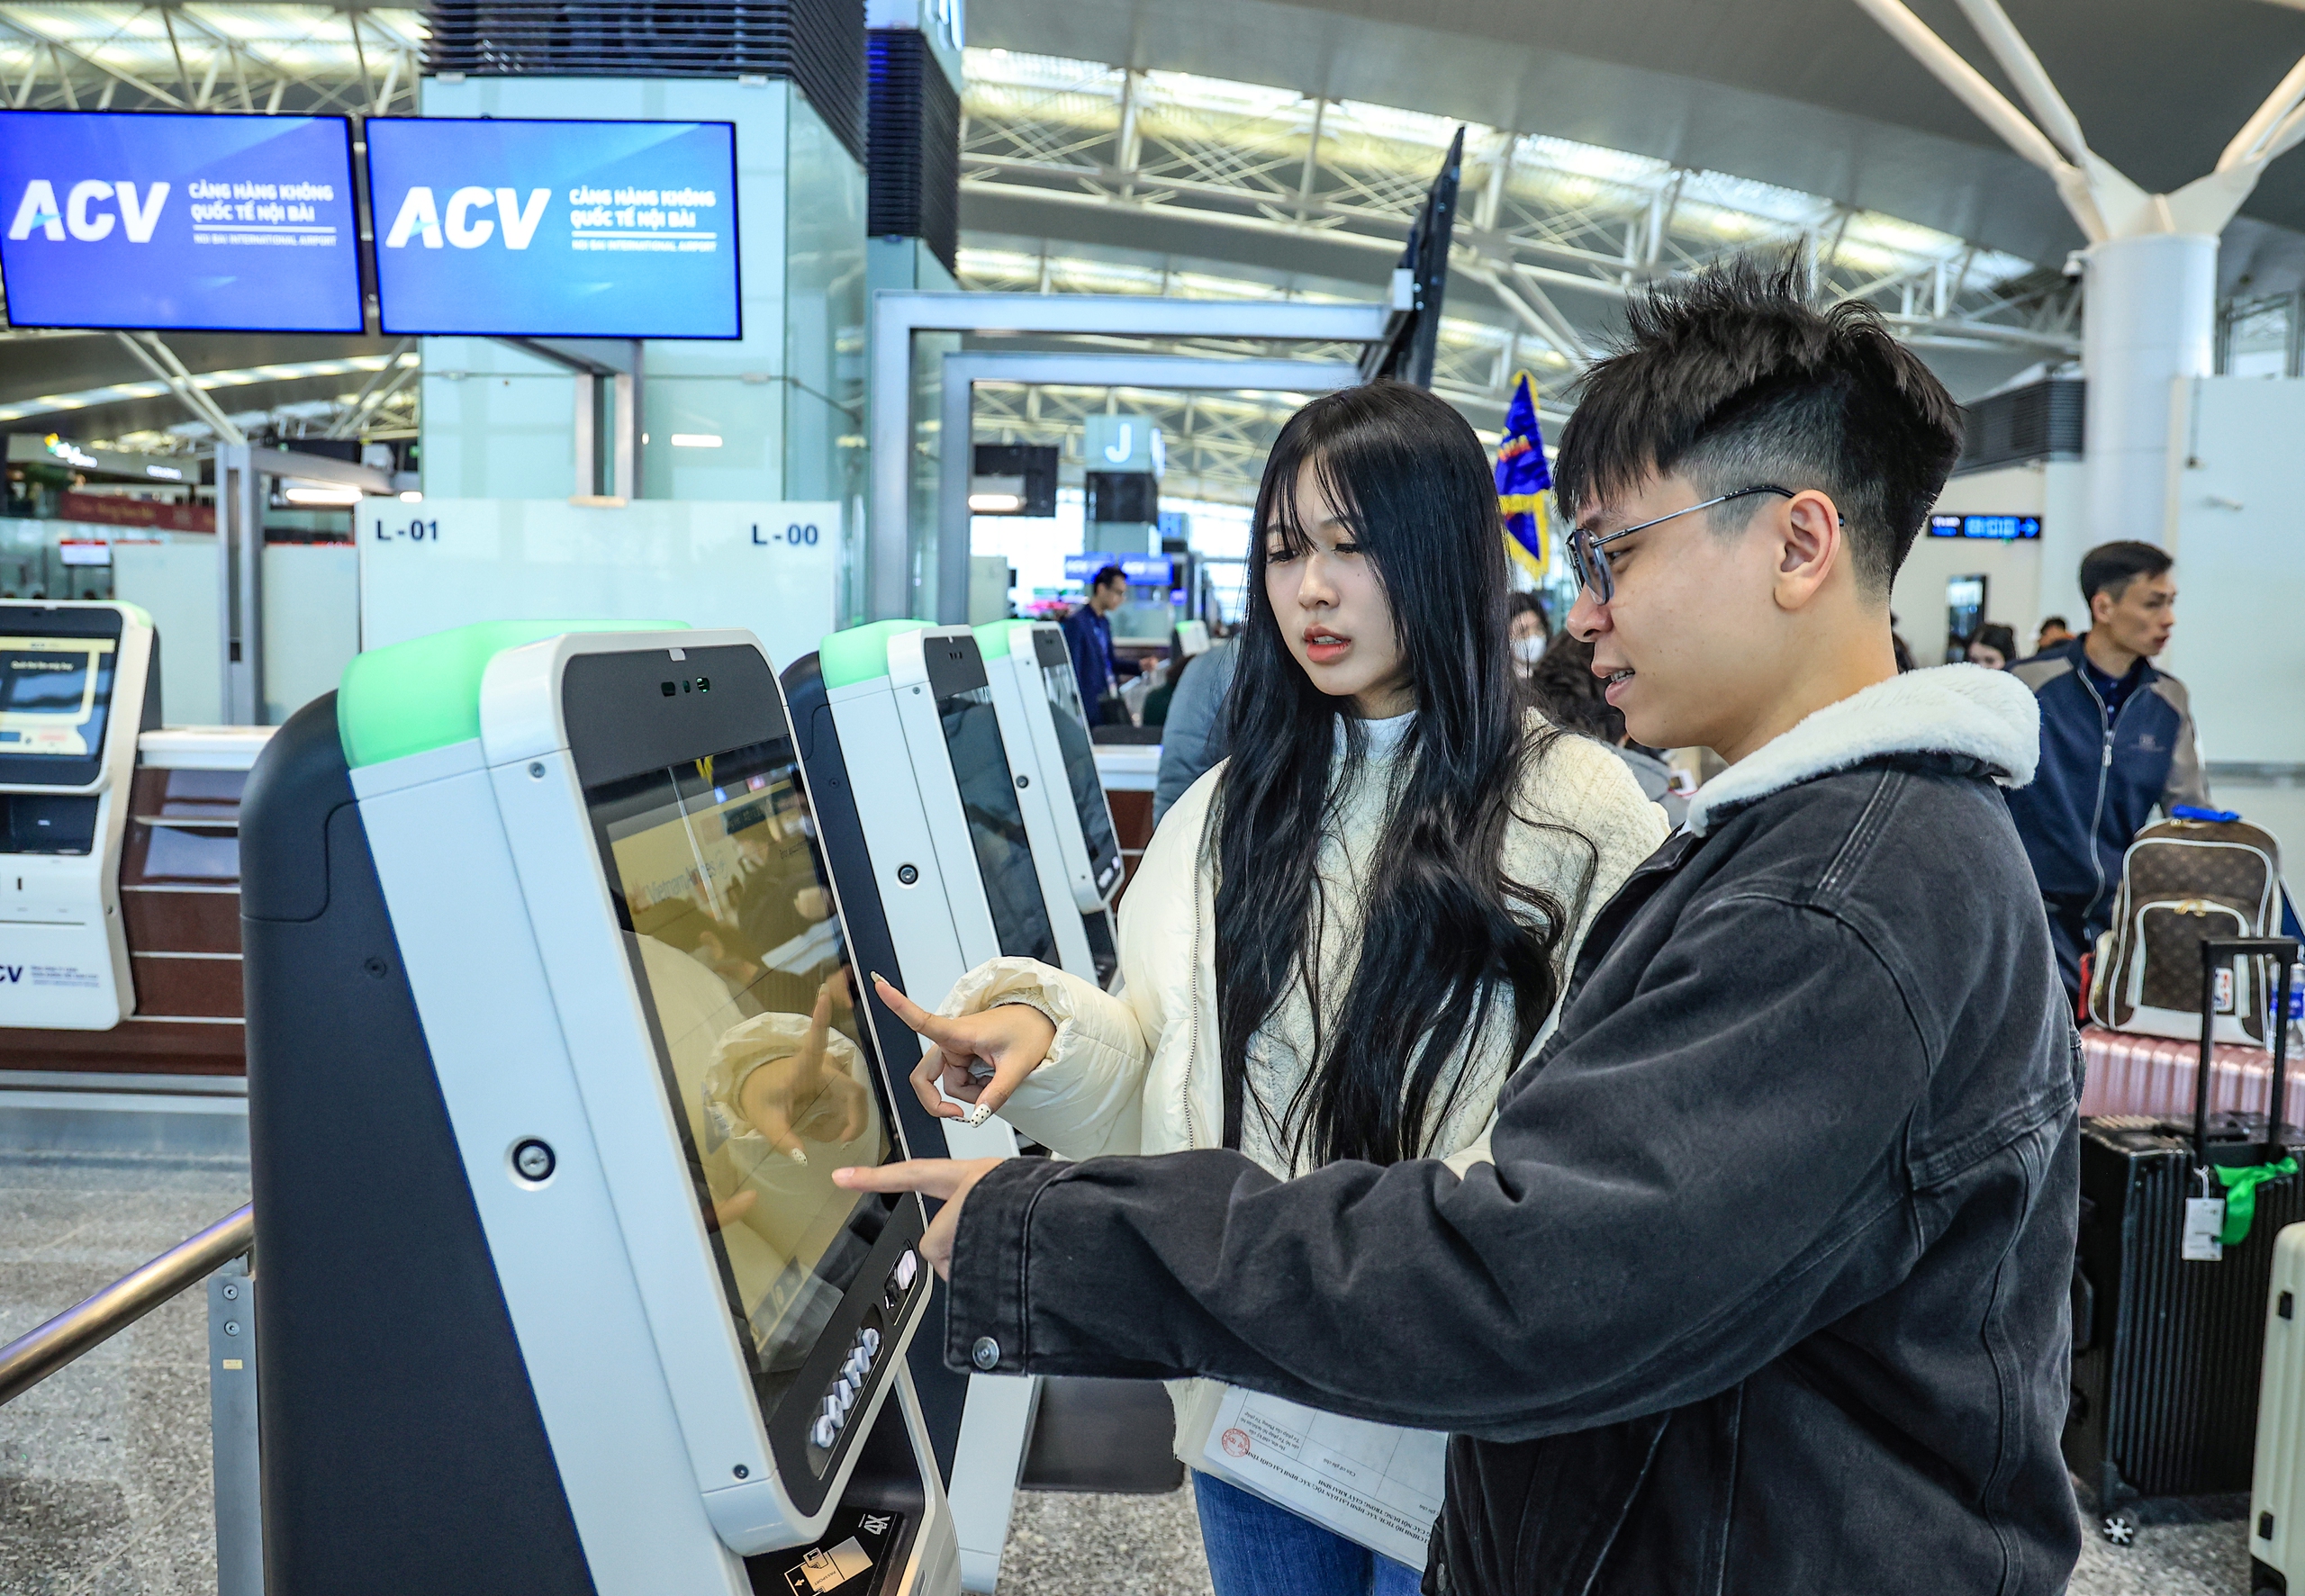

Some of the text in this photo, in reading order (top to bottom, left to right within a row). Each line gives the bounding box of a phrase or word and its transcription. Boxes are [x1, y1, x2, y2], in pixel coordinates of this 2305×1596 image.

[233, 180, 277, 201] HÀNG
[279, 181, 334, 202] KHÔNG
[614, 185, 659, 206] HÀNG
[661, 186, 717, 207] KHÔNG
[8, 178, 171, 243] ACV
[191, 200, 315, 225] QUỐC TẾ NỘI BÀI
[384, 185, 552, 251] ACV
[570, 205, 696, 230] QUỐC TẾ NỘI BÀI
[1104, 422, 1133, 464] J
[375, 519, 440, 541] L-01
[752, 523, 818, 546] L-00
[1259, 1457, 1273, 1468] GIỚI
[1271, 1464, 1284, 1473] LẠI
[1282, 1469, 1298, 1481] ĐỊNH
[1297, 1477, 1311, 1487] XÁC
[1317, 1479, 1333, 1490] SINH
[1324, 1491, 1339, 1501] DÂN
[1332, 1486, 1348, 1497] KHAI
[1338, 1496, 1350, 1506] LẠI
[1349, 1501, 1365, 1513] ĐỊNH
[1362, 1501, 1383, 1514] TRONG
[1363, 1509, 1378, 1519] XÁC
[1383, 1510, 1401, 1523] DUNG
[1394, 1524, 1404, 1532] HỘ
[1399, 1519, 1412, 1529] NỘI
[1404, 1528, 1424, 1542] CHÍNH
[1411, 1525, 1425, 1536] CÁC
[814, 1570, 836, 1586] PASSPORT
